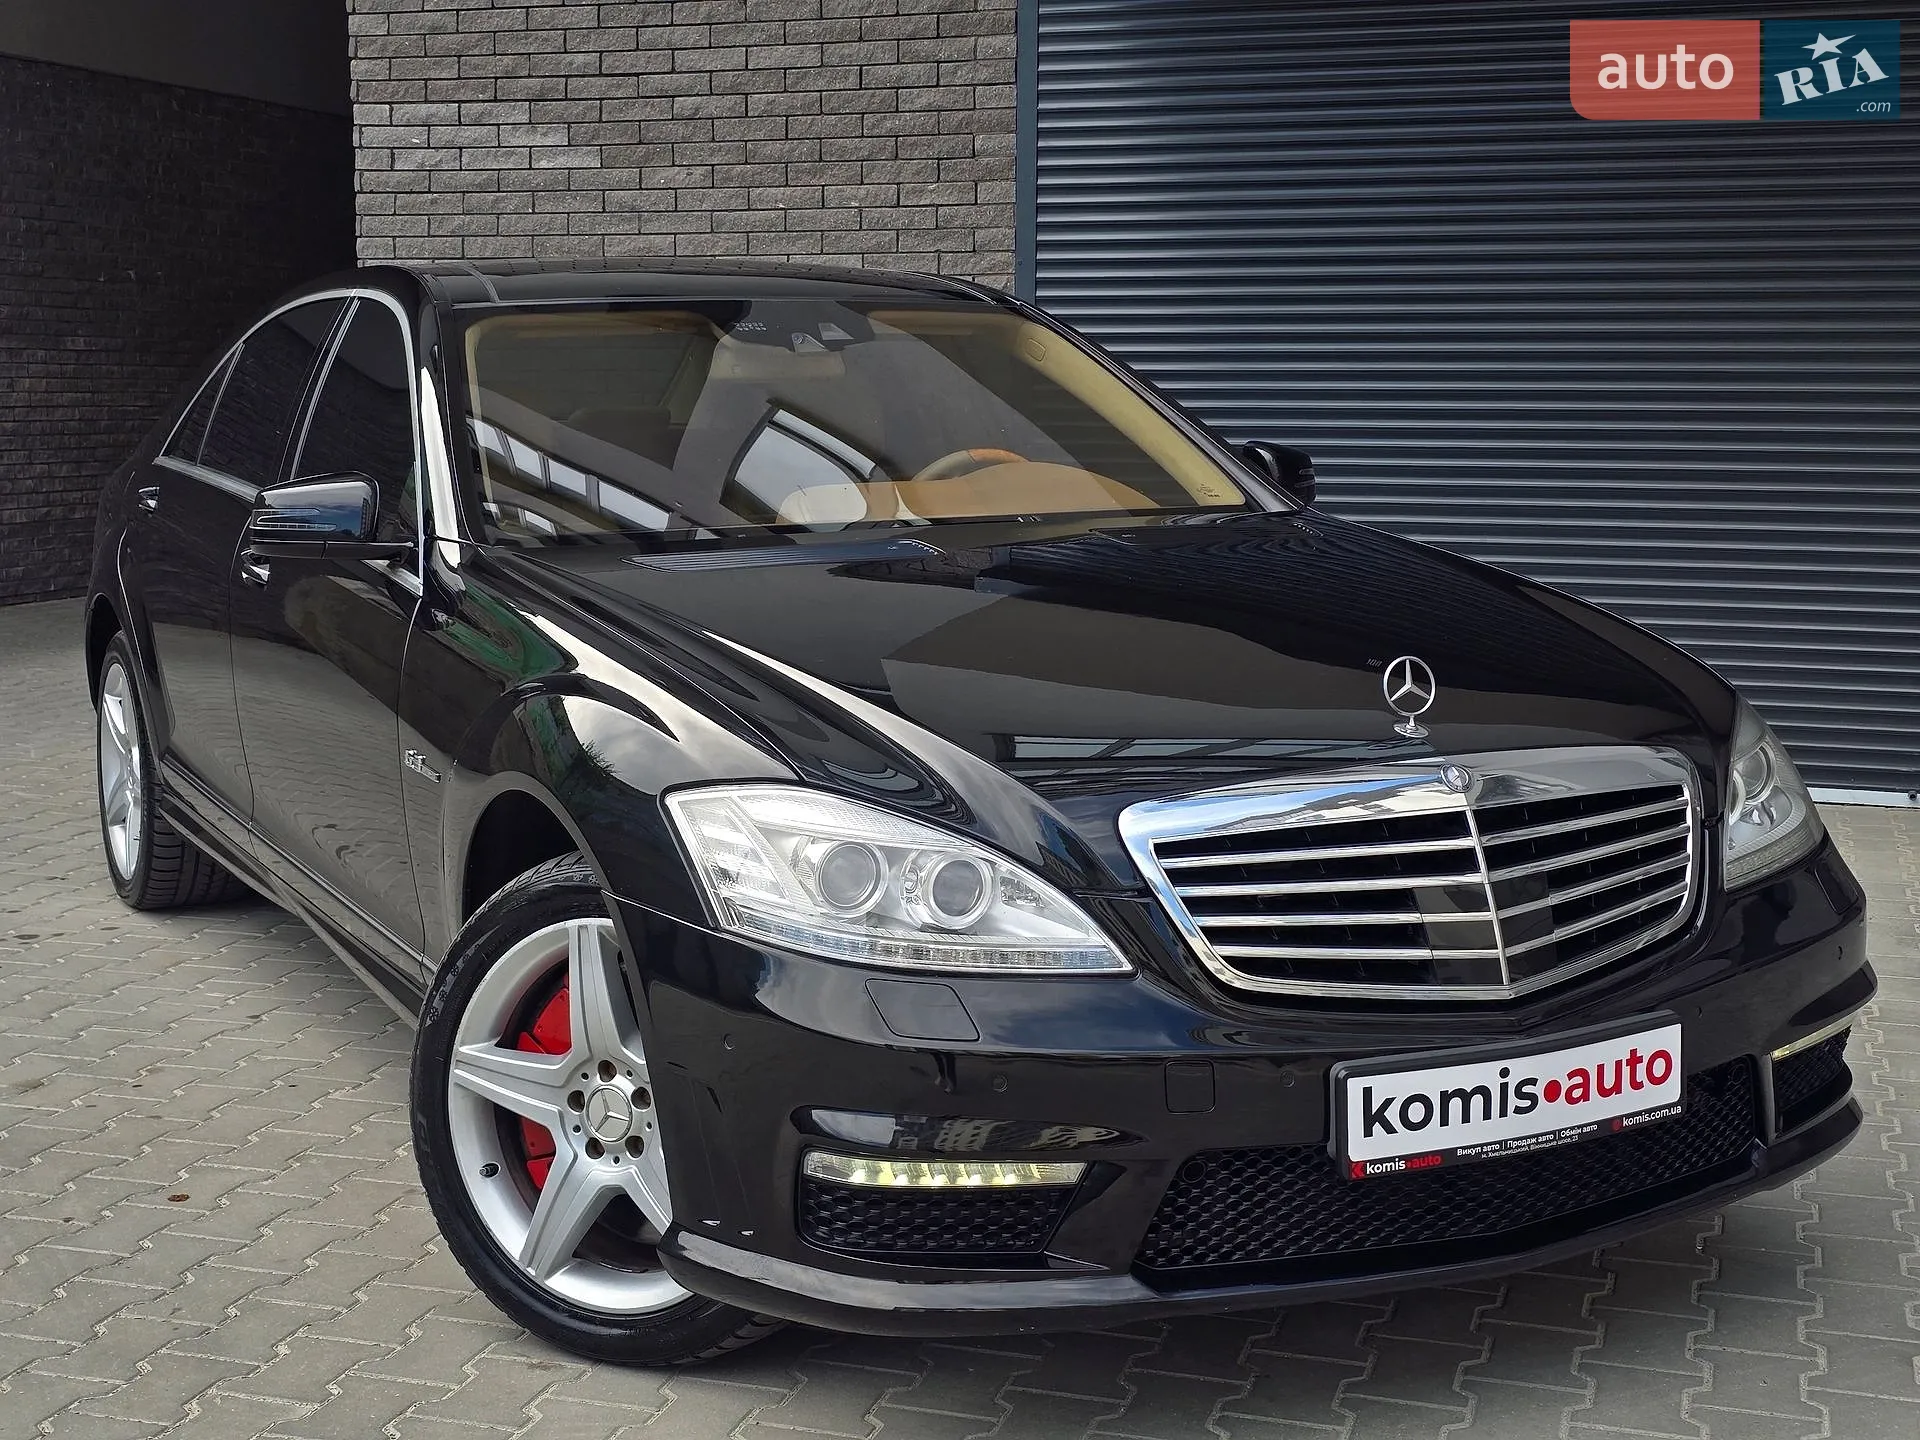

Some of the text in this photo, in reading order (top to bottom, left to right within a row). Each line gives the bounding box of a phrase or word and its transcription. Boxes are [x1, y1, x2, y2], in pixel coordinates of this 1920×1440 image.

[1622, 1105, 1682, 1127] komis.com.ua
[1457, 1124, 1598, 1156] Викуп авто Продаж авто Обмін авто
